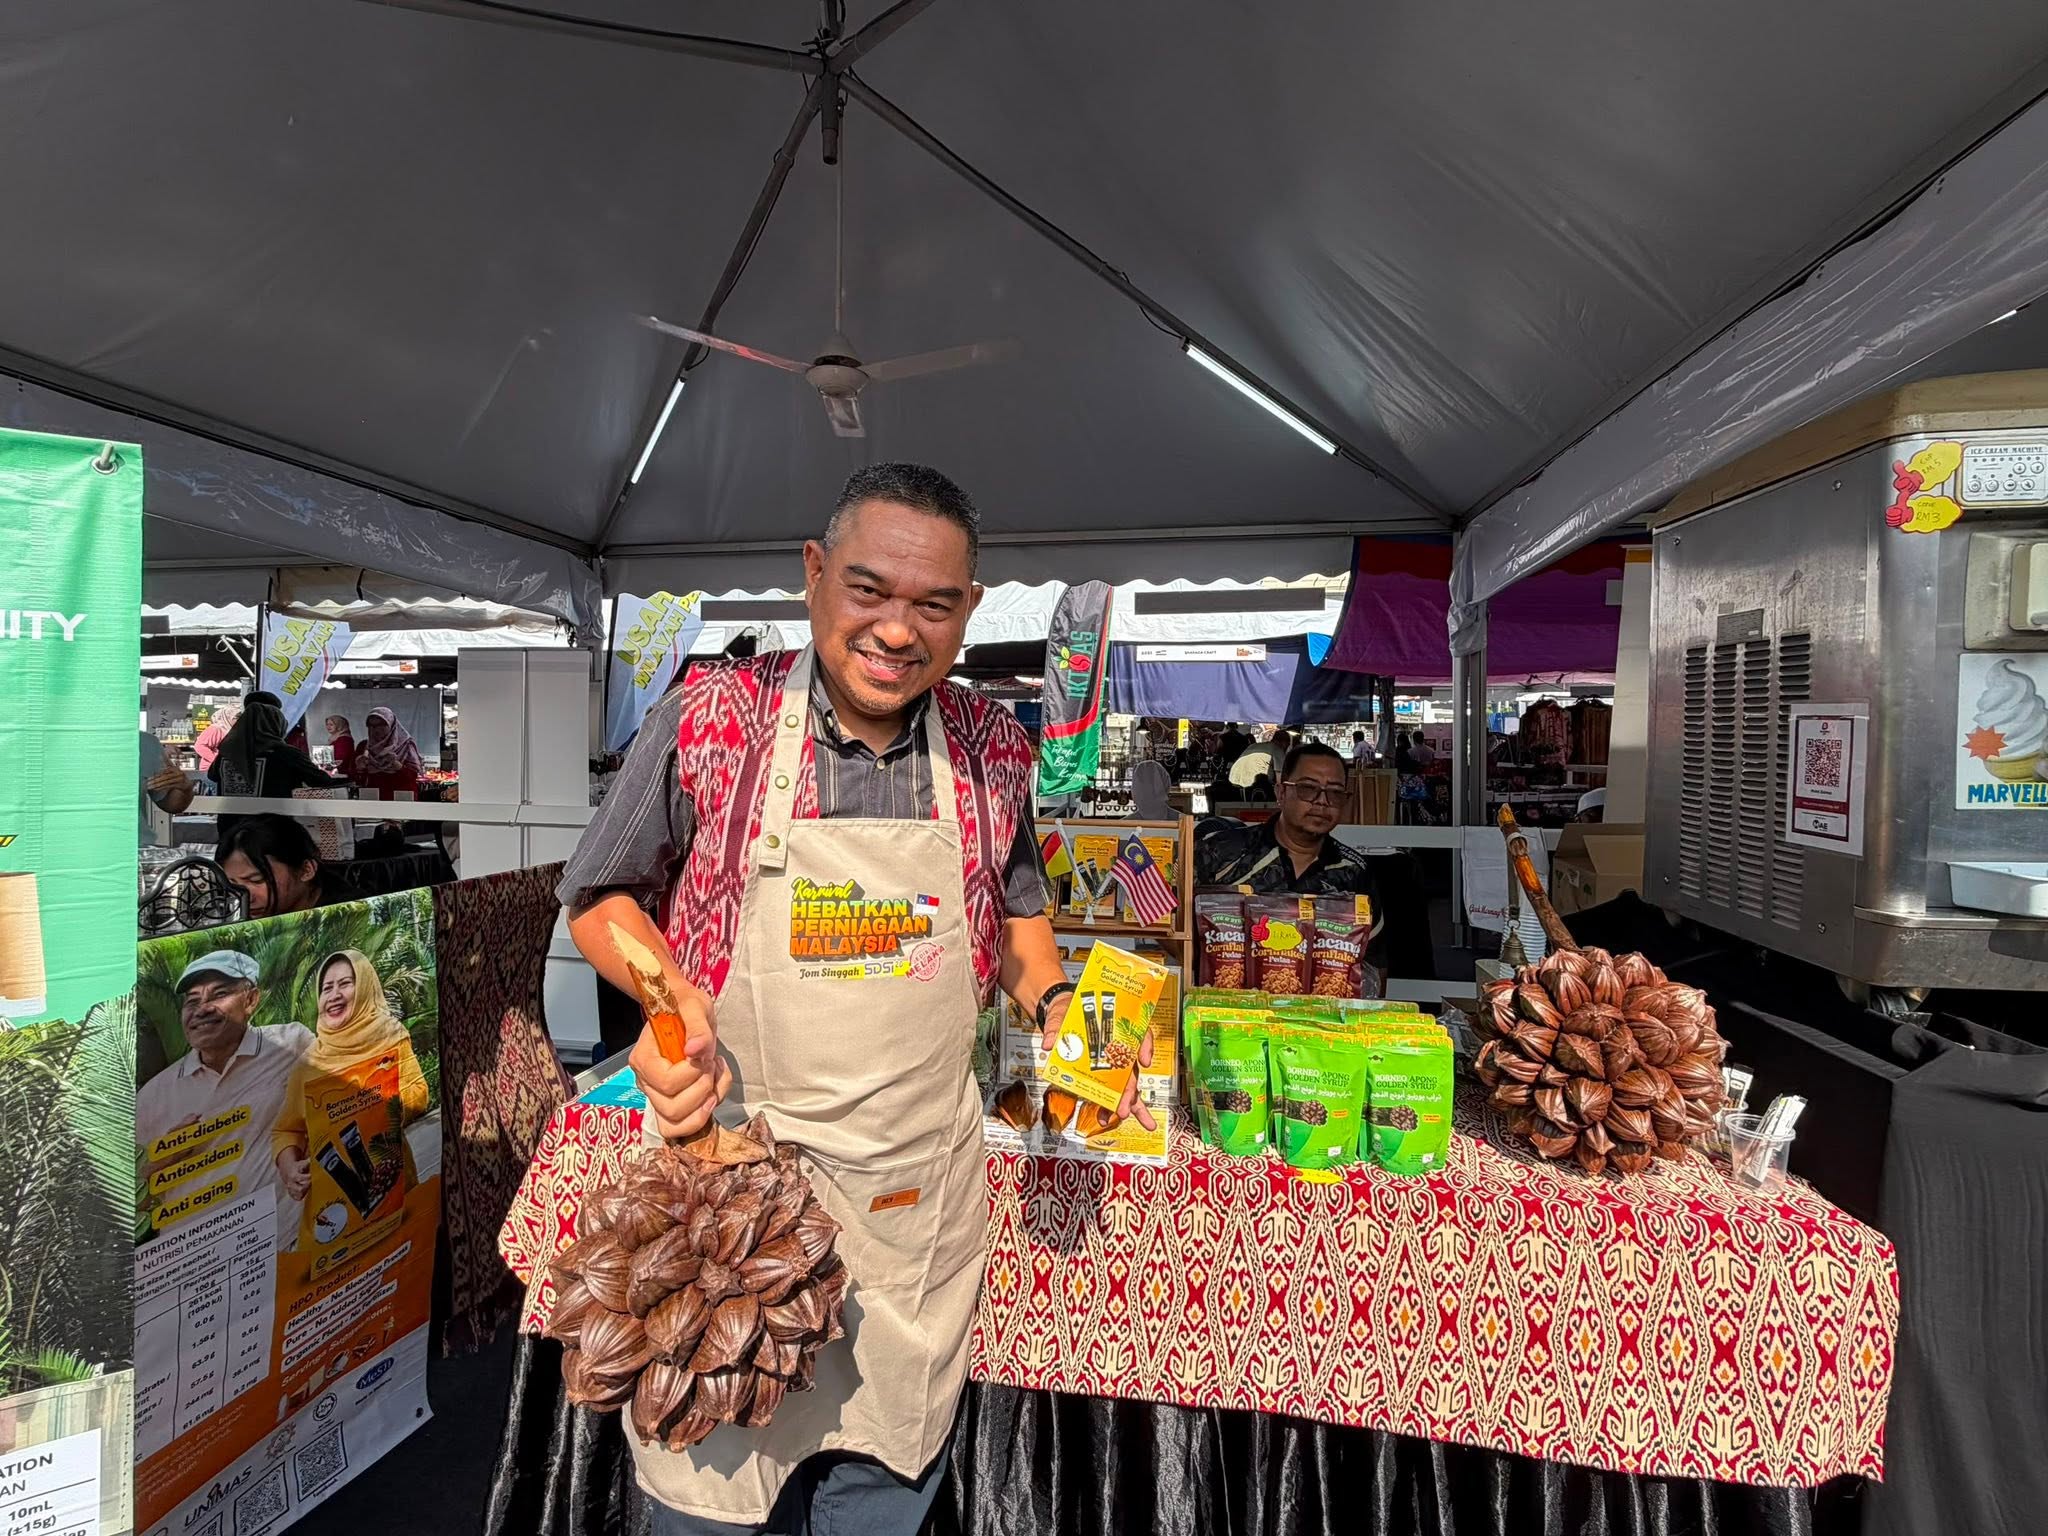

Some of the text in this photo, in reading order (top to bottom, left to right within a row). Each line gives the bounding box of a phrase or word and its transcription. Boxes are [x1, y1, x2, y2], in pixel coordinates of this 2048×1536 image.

[264, 619, 318, 675] USA
[281, 621, 336, 696] WILAYAH
[633, 609, 687, 690] WILAYAH
[792, 877, 856, 900] Karnival
[791, 899, 909, 919] HEBATKAN
[791, 916, 929, 937] PERNIAGAAN
[791, 935, 899, 957] MALAYSIA
[1251, 948, 1306, 961] Cornakes
[1312, 936, 1361, 958] acang
[1312, 949, 1356, 963] ornflakes
[905, 945, 945, 978] MELAKA
[799, 968, 820, 980] Jom
[820, 967, 861, 979] Singgah
[1244, 1065, 1266, 1073] SYRU
[1287, 1066, 1350, 1081] BORNEO APONG
[1288, 1073, 1349, 1088] GOLDEN SYRUP
[1375, 1074, 1438, 1084] BORNEO APONG
[326, 1084, 382, 1111] Borneo Apong
[1376, 1081, 1437, 1091] GOLDEN SYRUP
[328, 1102, 358, 1120] Golden
[359, 1093, 382, 1107] Syrup
[154, 1110, 248, 1154] Anti-diabetic
[155, 1143, 241, 1187] Antioxidant
[157, 1181, 234, 1222] Anti aging
[135, 1199, 256, 1262] UTRITION INFORMATION
[236, 1226, 257, 1241] 10mL
[142, 1216, 245, 1272] NUTRISI PEMAKANAN
[233, 1240, 273, 1264] Per/setiap
[147, 1250, 211, 1286] size per sachet
[250, 1261, 267, 1274] kcal
[135, 1280, 171, 1301] dangan
[195, 1281, 210, 1294] 100
[204, 1285, 223, 1299] kcal
[286, 1302, 324, 1330] Healthy
[330, 1290, 343, 1301] No
[344, 1265, 383, 1293] Bleaching
[288, 1264, 361, 1314] HPO Product:
[285, 1330, 308, 1348] Pure
[315, 1316, 328, 1329] No
[329, 1295, 358, 1319] Added
[284, 1335, 322, 1367] Organic
[321, 1320, 345, 1341] Plant
[134, 1376, 166, 1400] ydrate
[184, 1465, 253, 1528] UNIMAS
[8, 1500, 54, 1521] 10mL
[7, 1514, 57, 1536] (±15g)
